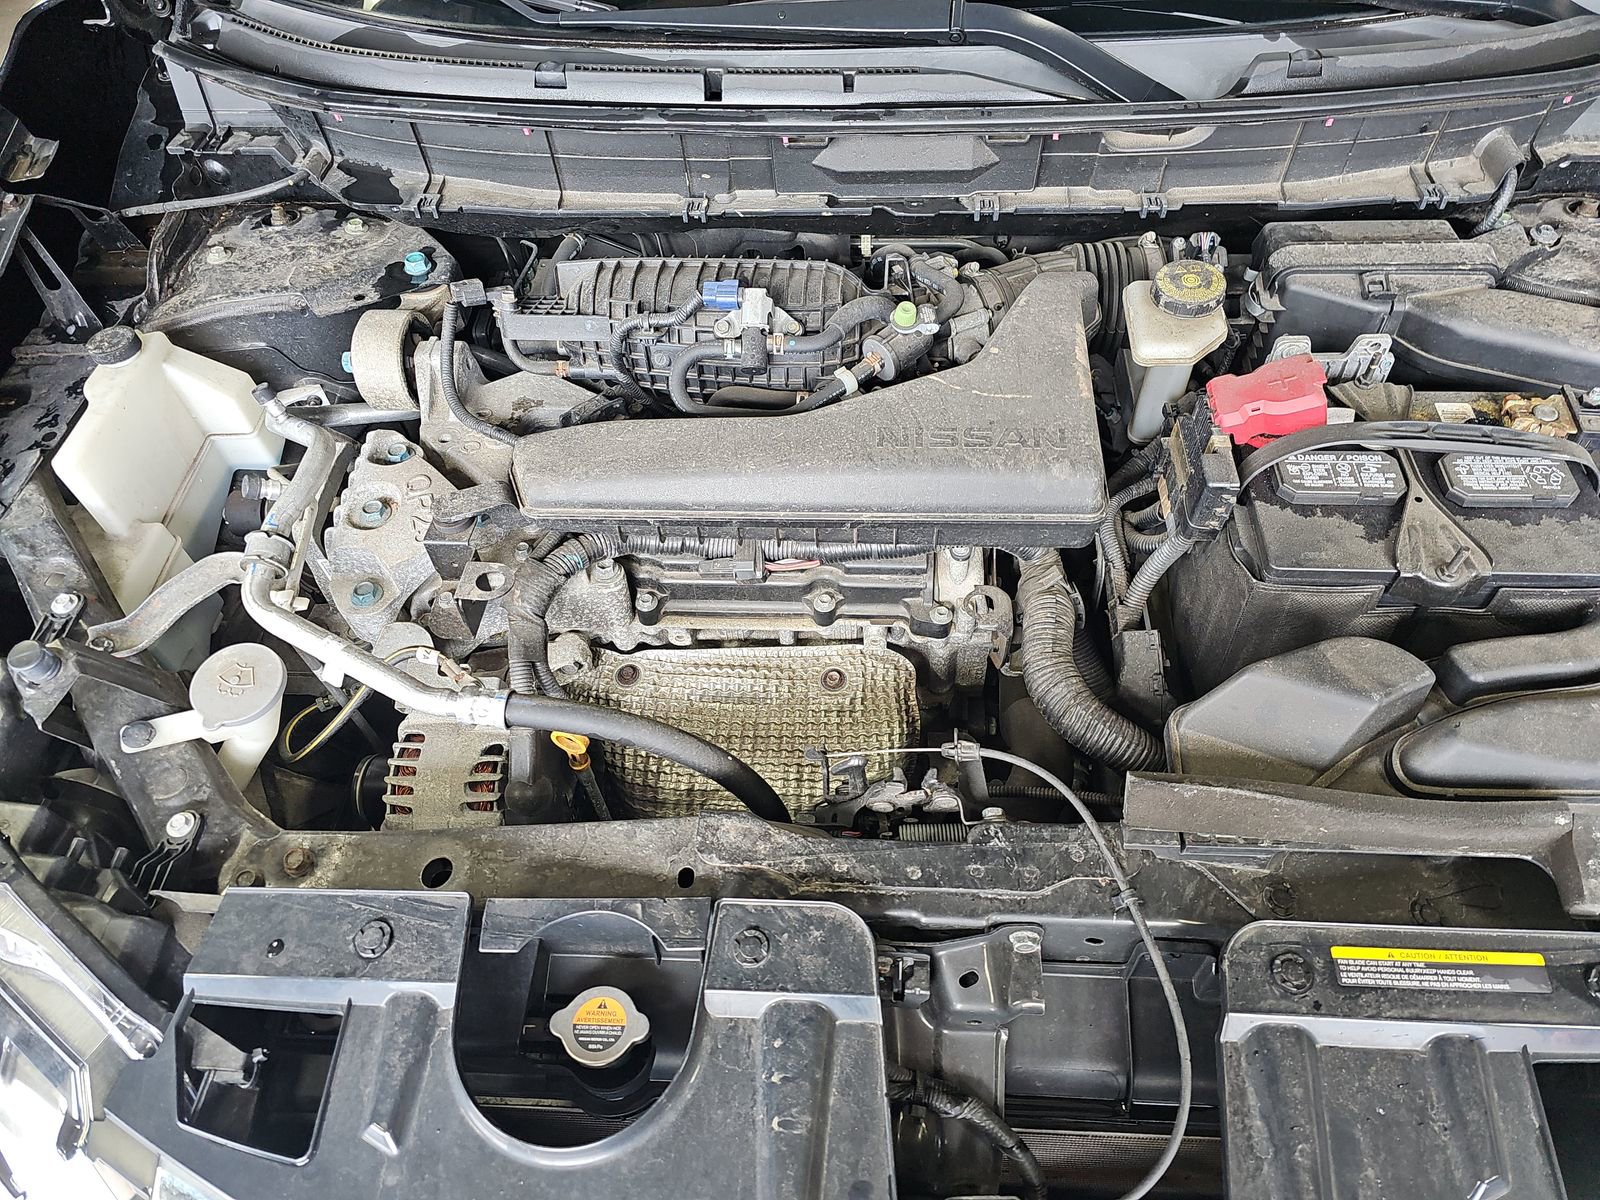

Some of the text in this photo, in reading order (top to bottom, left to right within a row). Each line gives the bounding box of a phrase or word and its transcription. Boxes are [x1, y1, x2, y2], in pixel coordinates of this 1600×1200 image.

[875, 426, 1067, 449] NISSAN
[1400, 952, 1436, 960] CAUTION
[1444, 954, 1488, 962] ATTENTION
